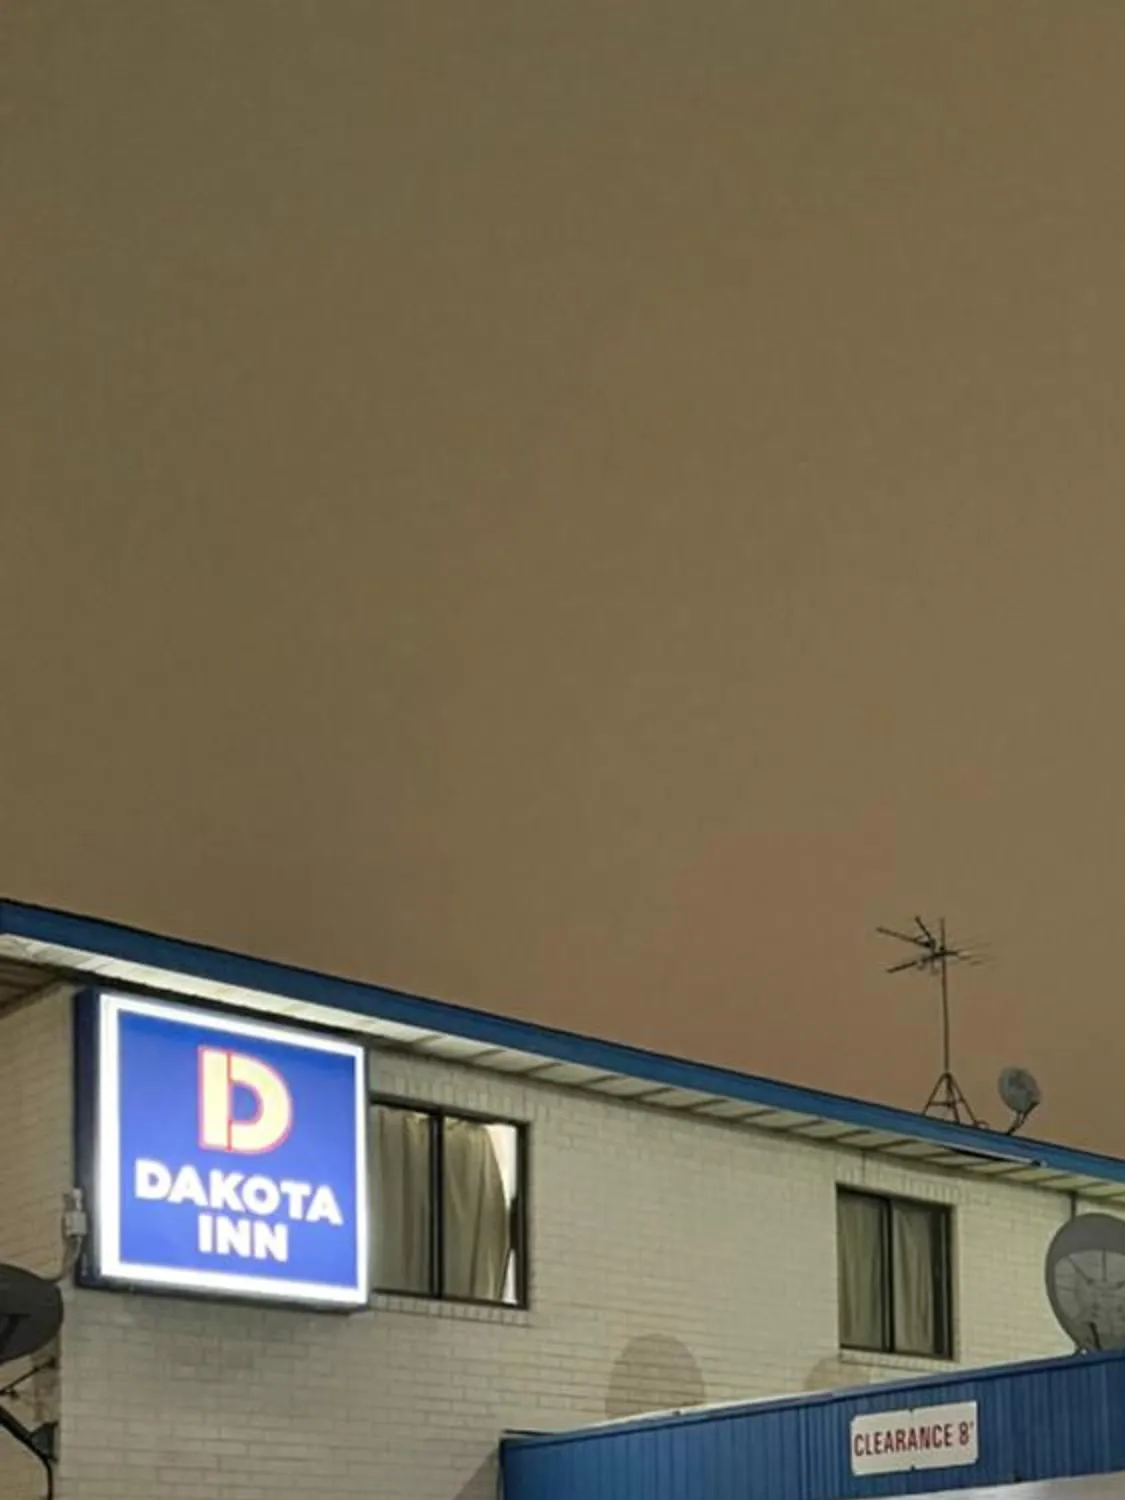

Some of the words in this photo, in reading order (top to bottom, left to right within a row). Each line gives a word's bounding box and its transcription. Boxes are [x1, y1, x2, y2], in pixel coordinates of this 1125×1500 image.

[198, 1045, 292, 1153] D
[134, 1158, 343, 1226] DAKOTA
[197, 1212, 288, 1263] INN
[854, 1424, 953, 1456] CLEARANCE
